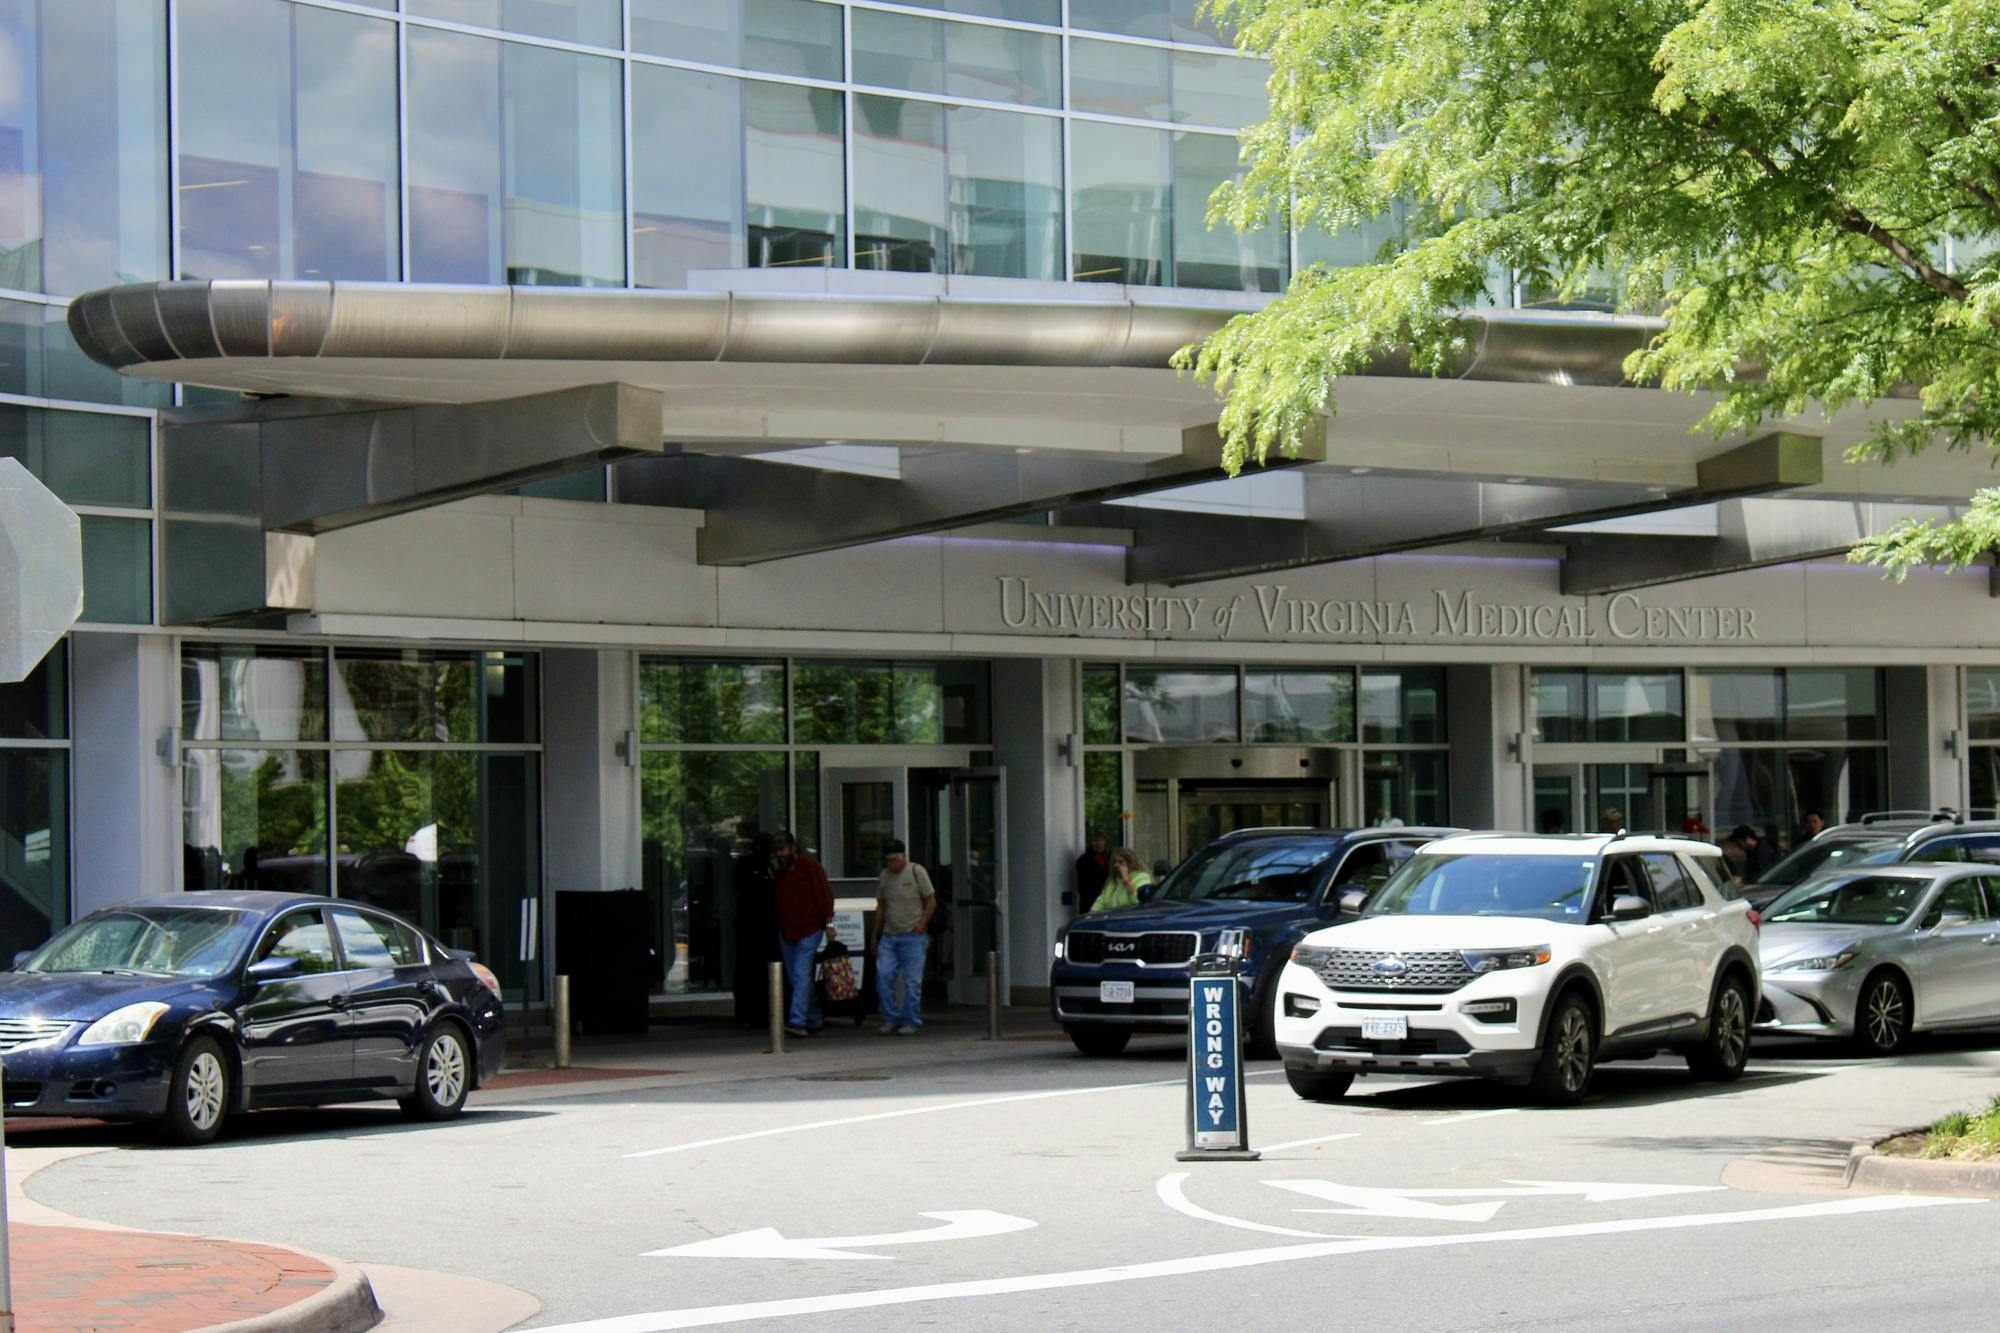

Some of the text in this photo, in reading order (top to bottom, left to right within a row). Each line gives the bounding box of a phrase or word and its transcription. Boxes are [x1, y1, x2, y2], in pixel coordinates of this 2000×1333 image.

[998, 576, 1759, 640] UNIVERSITY of VIRGINIA MEDICAL CENTER
[1203, 987, 1226, 1125] WRONG WAY
